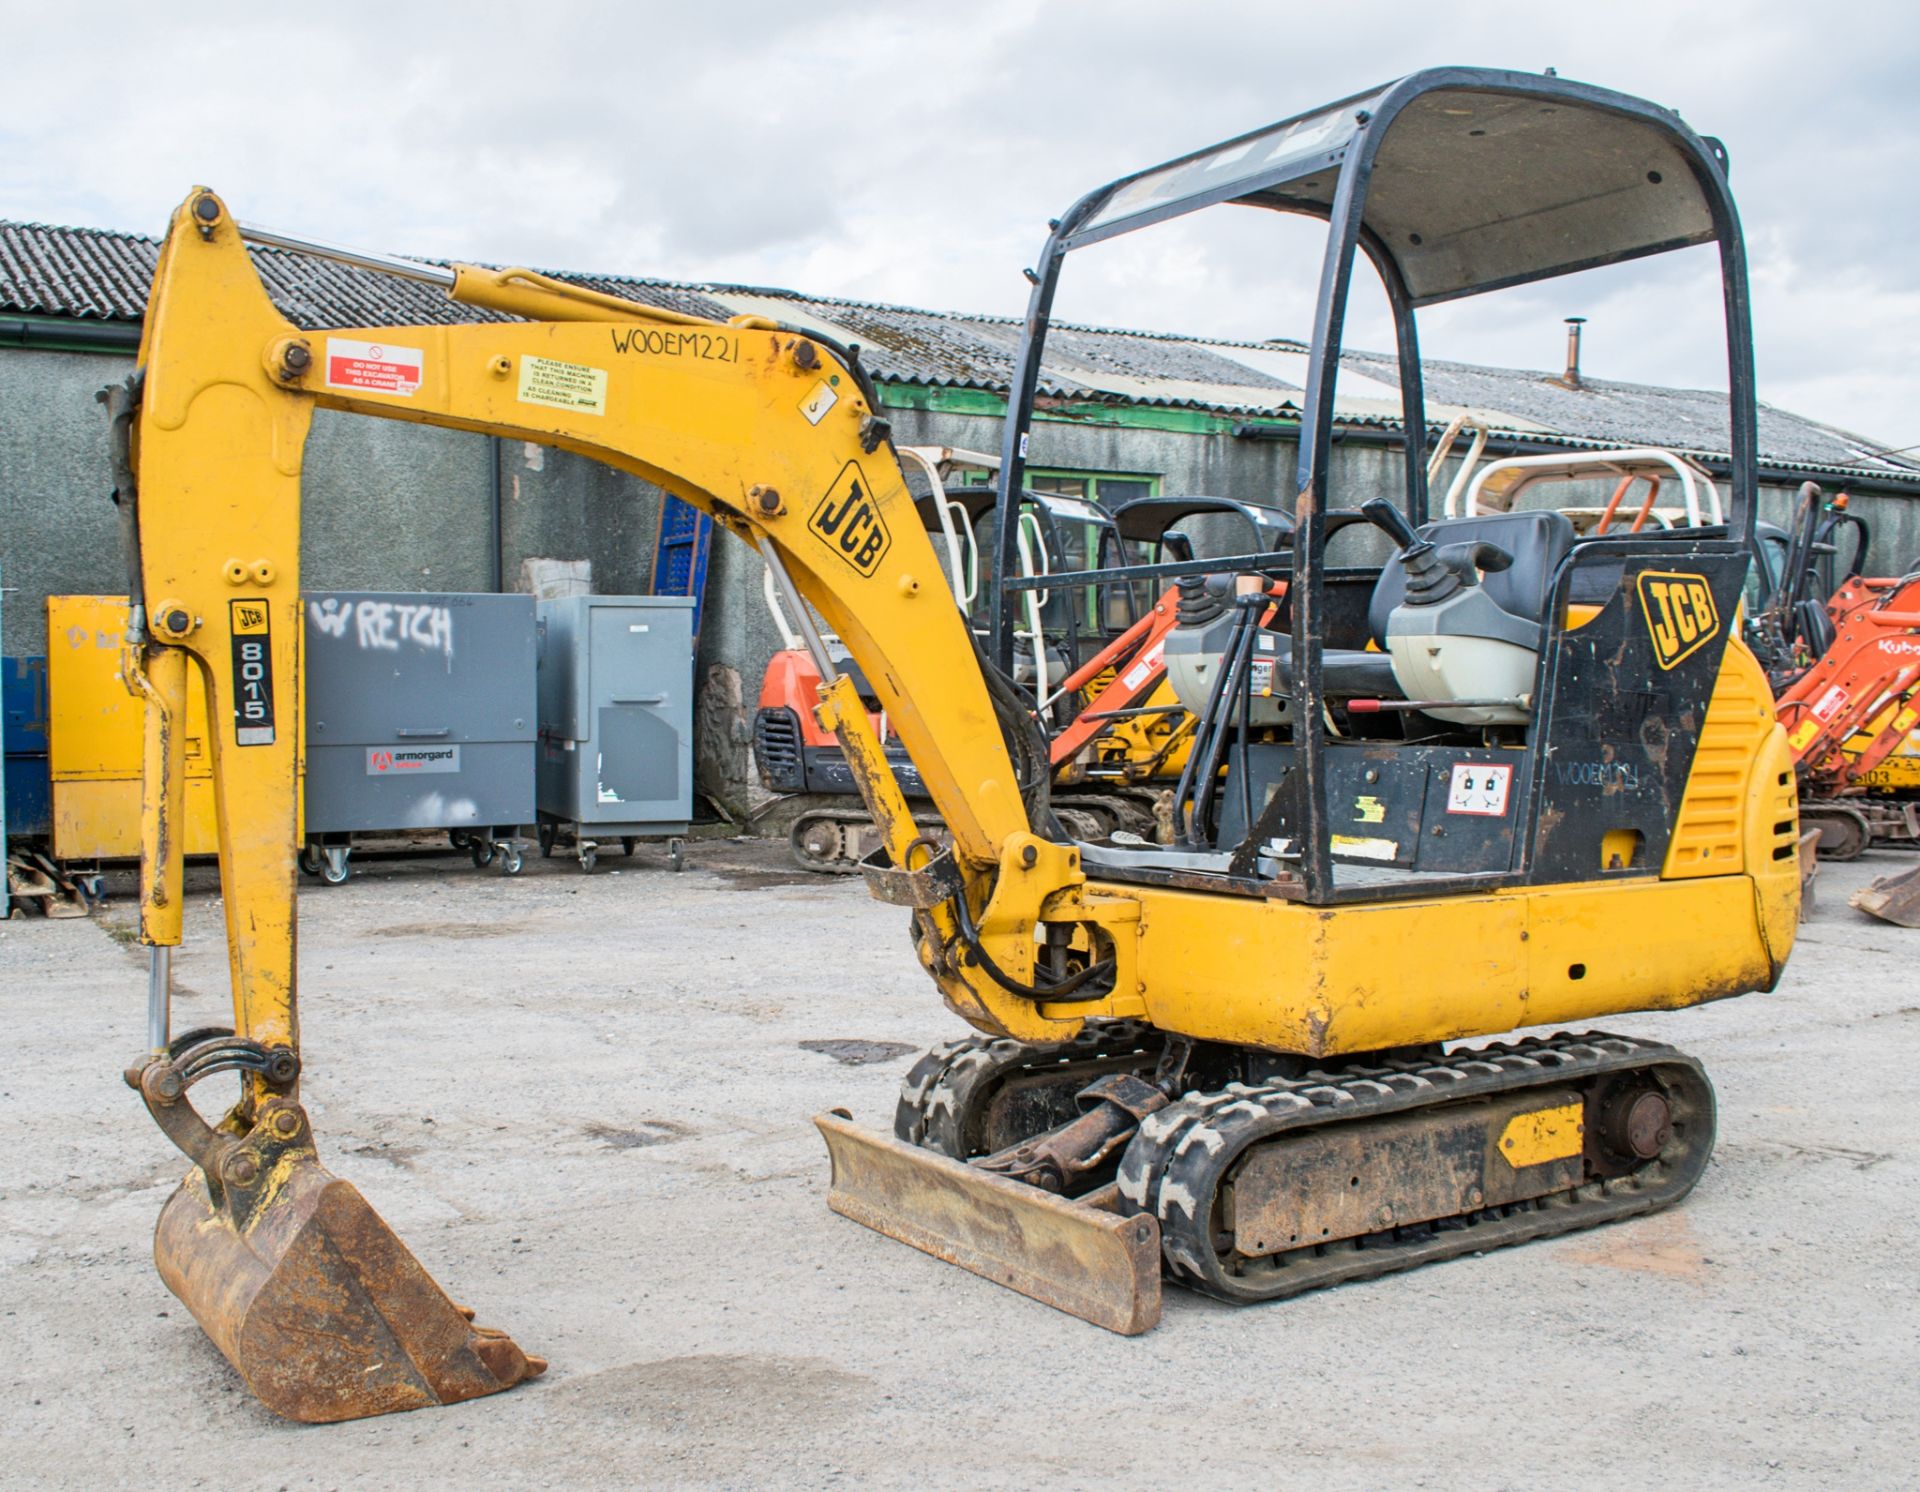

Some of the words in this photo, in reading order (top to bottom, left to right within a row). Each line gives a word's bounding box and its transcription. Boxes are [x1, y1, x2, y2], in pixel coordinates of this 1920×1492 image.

[353, 361, 365, 369] DO
[366, 362, 381, 371] NOT
[382, 365, 397, 373] USE
[531, 363, 547, 371] THAT
[550, 367, 564, 375] THIS
[566, 370, 596, 380] MACHINE
[537, 358, 562, 368] PLEASE
[564, 364, 590, 373] ENSURE
[345, 368, 361, 376] THIS
[363, 370, 405, 381] EXCAVATOR
[542, 372, 577, 384] RETURNED
[371, 379, 396, 388] CRANE
[532, 377, 554, 386] CLEAN
[556, 381, 592, 393] CONDITION
[531, 392, 575, 405] CHARGEABLE
[538, 387, 572, 398] CLEANING
[815, 478, 883, 569] JCB
[240, 607, 263, 627] JCB
[1649, 581, 1713, 658] JCB
[240, 642, 265, 720] 8015
[394, 748, 453, 762] armorgard
